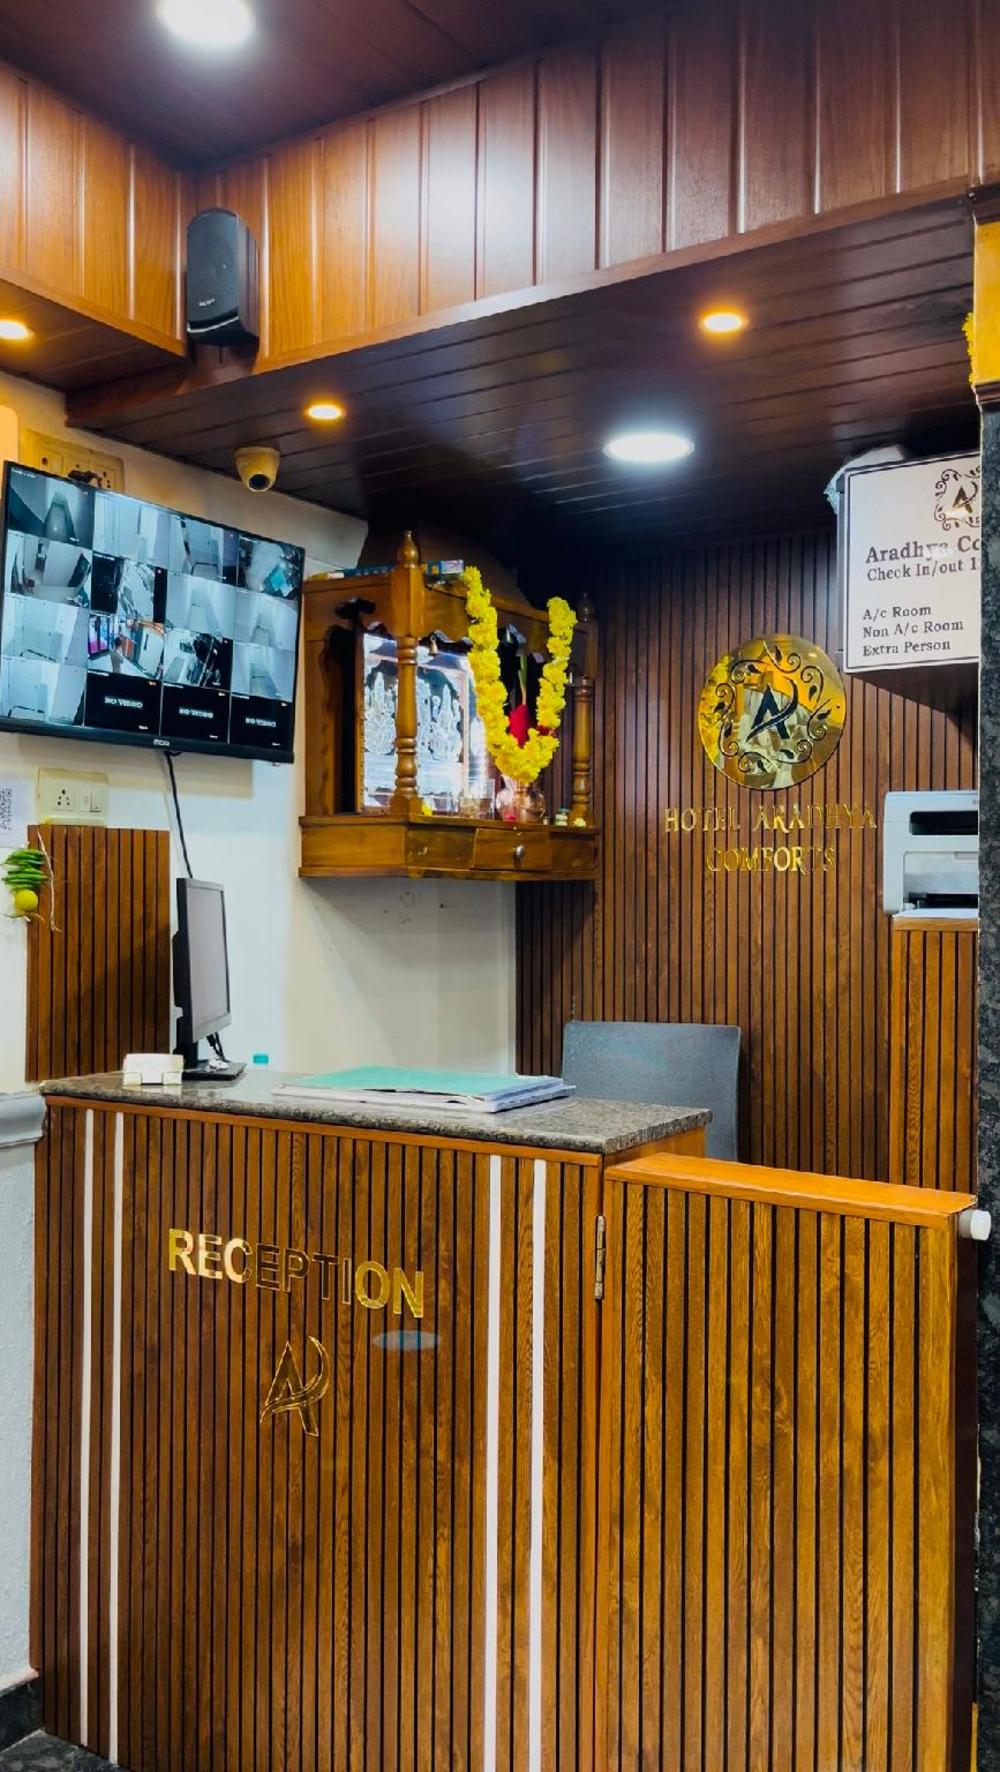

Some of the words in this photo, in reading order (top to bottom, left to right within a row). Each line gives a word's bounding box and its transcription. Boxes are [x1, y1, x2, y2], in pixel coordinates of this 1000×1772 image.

[867, 564, 911, 582] Check
[915, 559, 963, 578] In/out
[863, 608, 888, 622] A/c
[892, 605, 932, 617] Room
[863, 626, 889, 639] Non
[894, 622, 919, 637] A/c
[923, 620, 964, 633] Room
[863, 644, 899, 657] Extra
[904, 640, 951, 654] Person
[664, 805, 741, 833] HOTEL
[754, 801, 878, 833] ARADHYA
[705, 845, 837, 875] COMFORTS
[168, 1228, 425, 1319] RECEPTION
